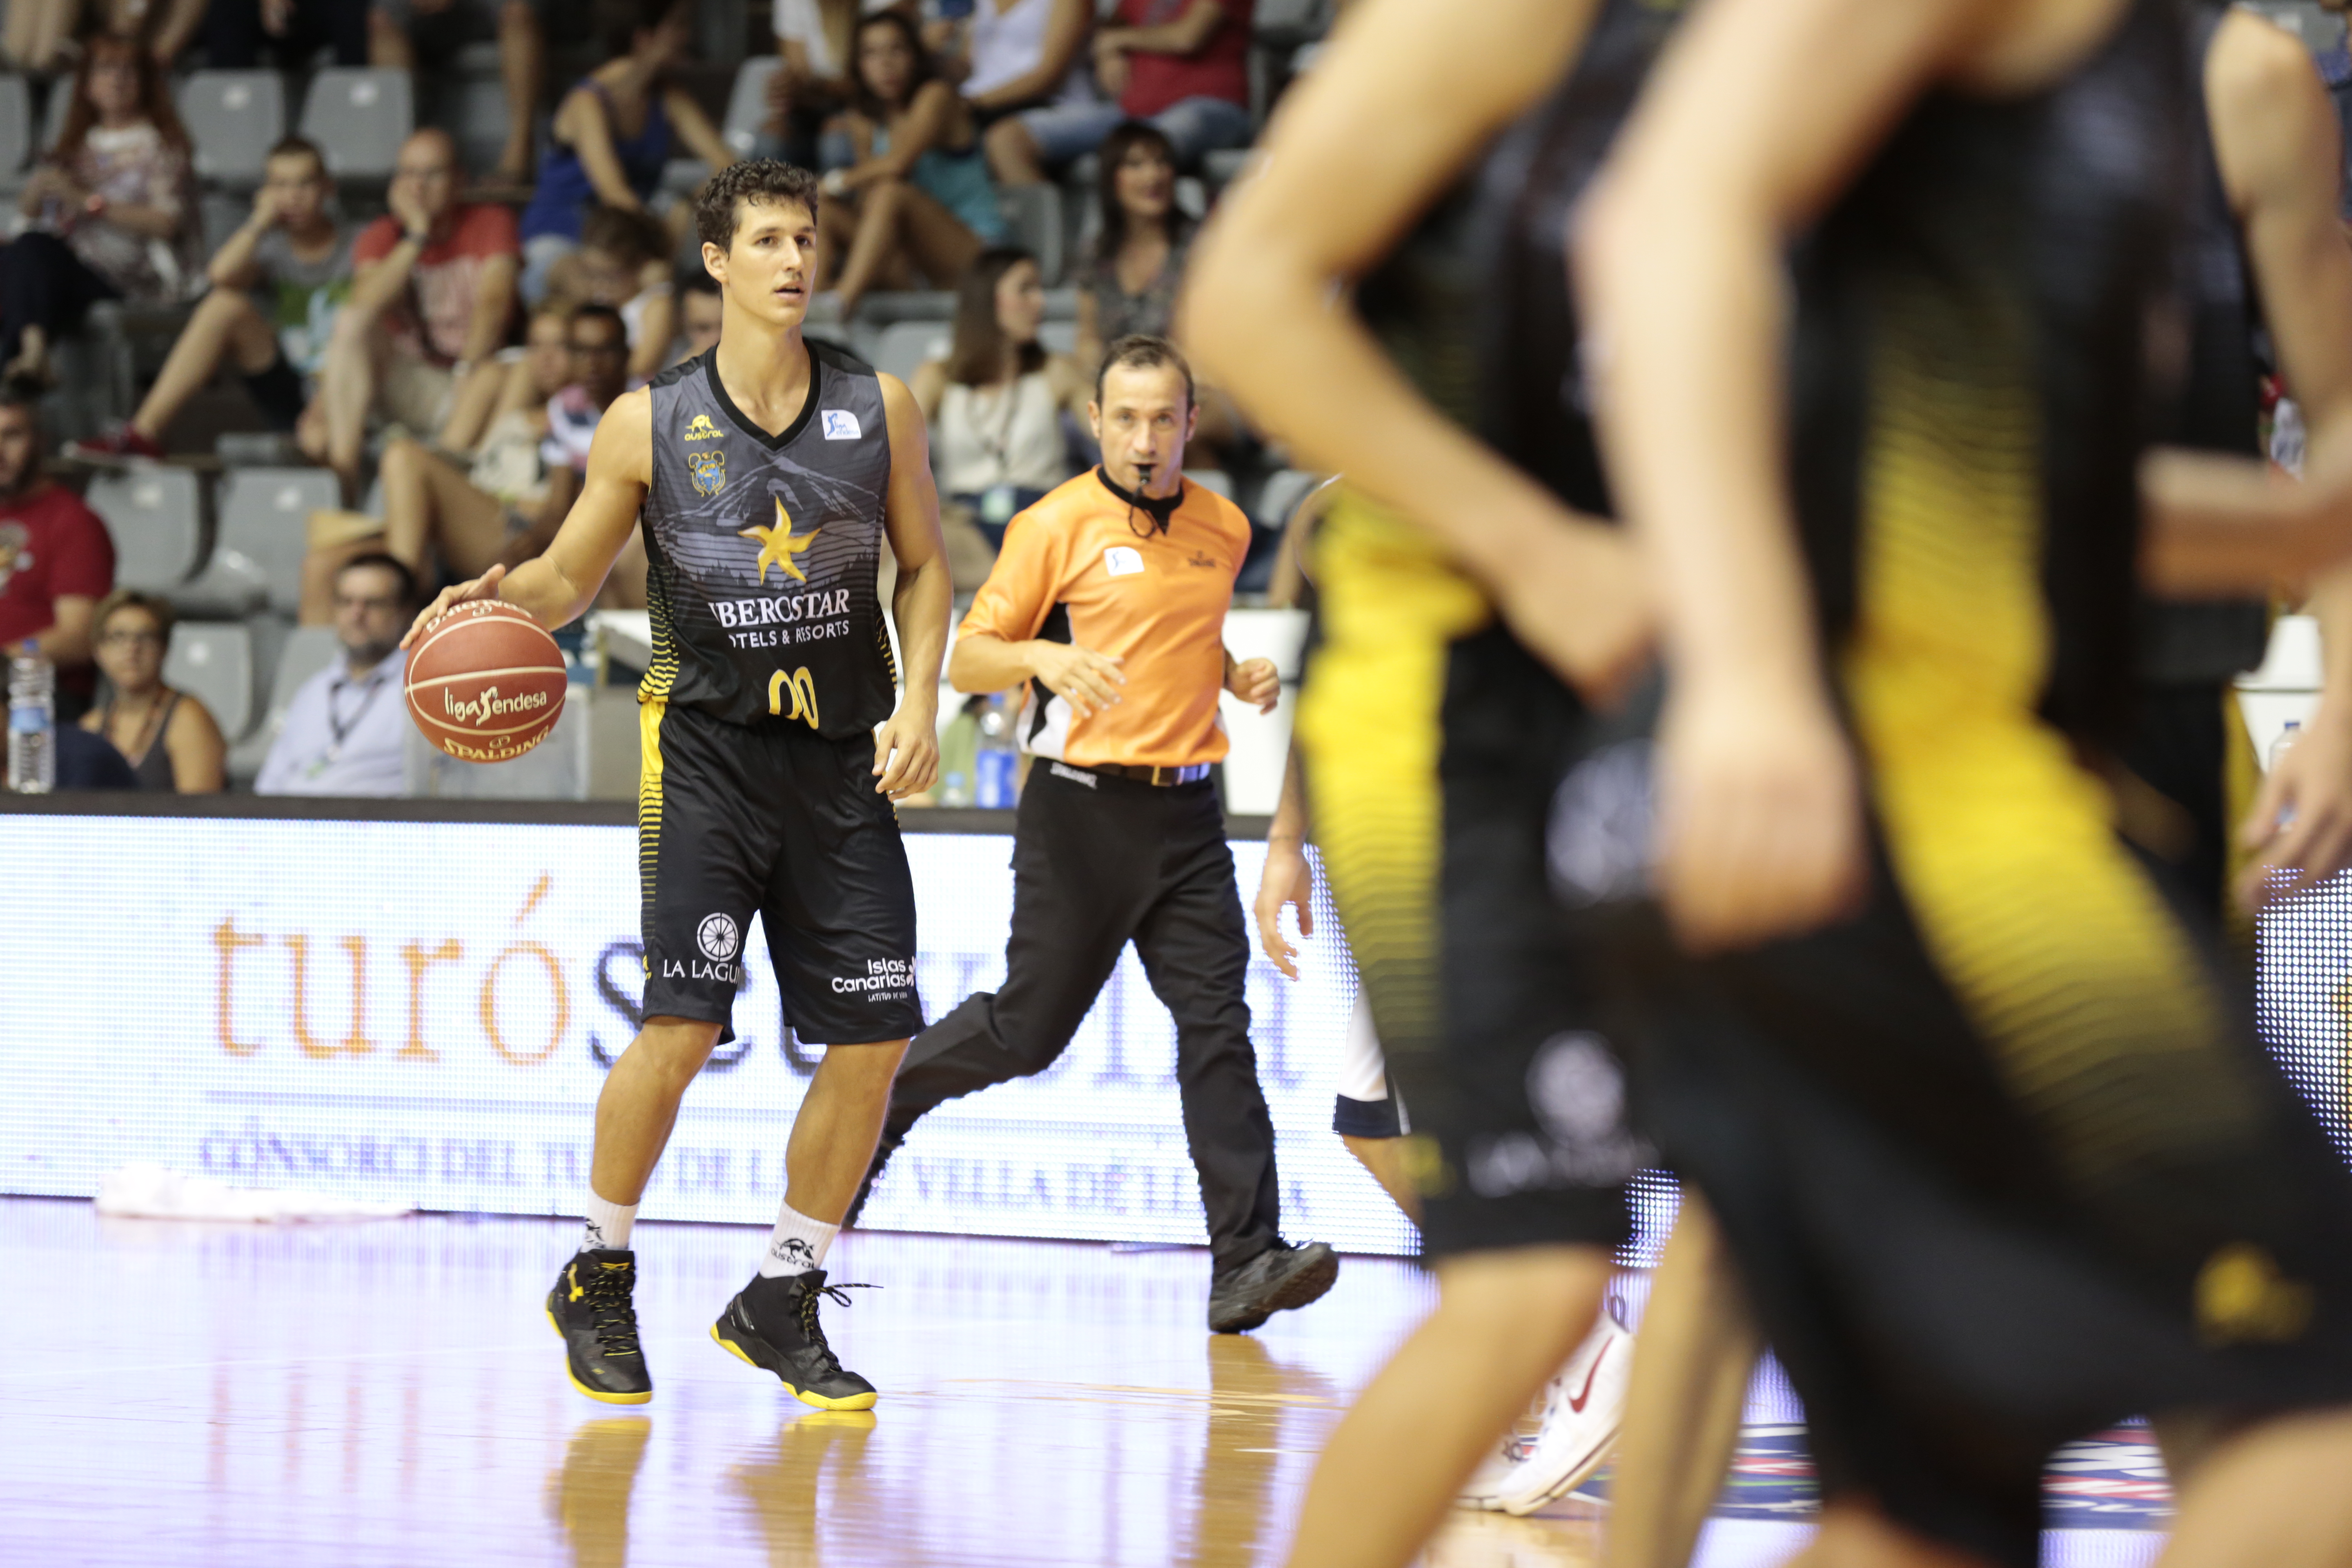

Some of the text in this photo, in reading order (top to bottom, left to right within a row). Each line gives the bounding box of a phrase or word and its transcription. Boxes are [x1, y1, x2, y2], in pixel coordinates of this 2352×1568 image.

[684, 430, 724, 441] austral
[782, 629, 790, 645] &
[796, 620, 849, 644] RESORTS
[444, 686, 547, 723] liga endesa
[443, 724, 549, 761] SPALDING
[213, 869, 571, 1067] turó
[663, 959, 686, 978] LA
[867, 957, 906, 975] Islas
[831, 972, 906, 993] Canarias
